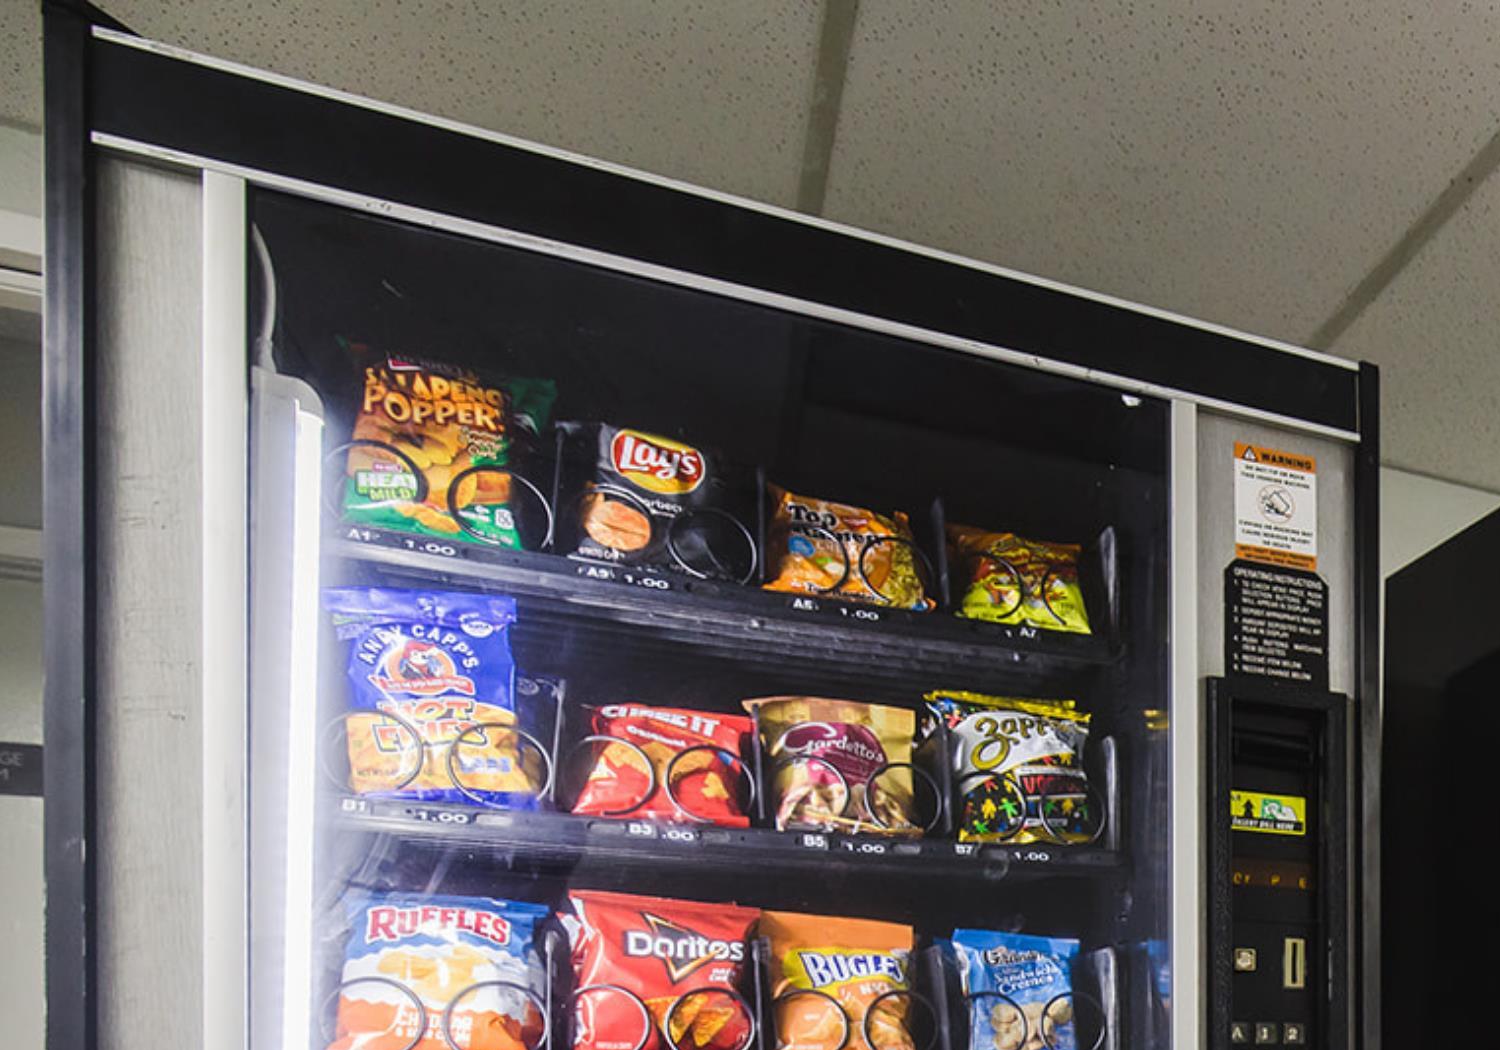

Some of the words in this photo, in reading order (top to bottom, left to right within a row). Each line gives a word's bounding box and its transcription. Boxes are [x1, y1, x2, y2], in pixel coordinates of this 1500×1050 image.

[619, 436, 698, 479] Lay's
[1261, 452, 1312, 470] WARNING
[788, 504, 837, 527] Top
[405, 540, 456, 556] 1.00
[624, 573, 669, 590] 1.00
[840, 606, 880, 621] 1.00
[411, 624, 480, 669] CAPP'S
[416, 811, 468, 824] 1.00
[803, 834, 825, 847] B5
[845, 842, 885, 853] 1.00
[1013, 851, 1049, 862] 1.00
[366, 905, 511, 945] RUFFLES
[626, 930, 744, 961] Doritos
